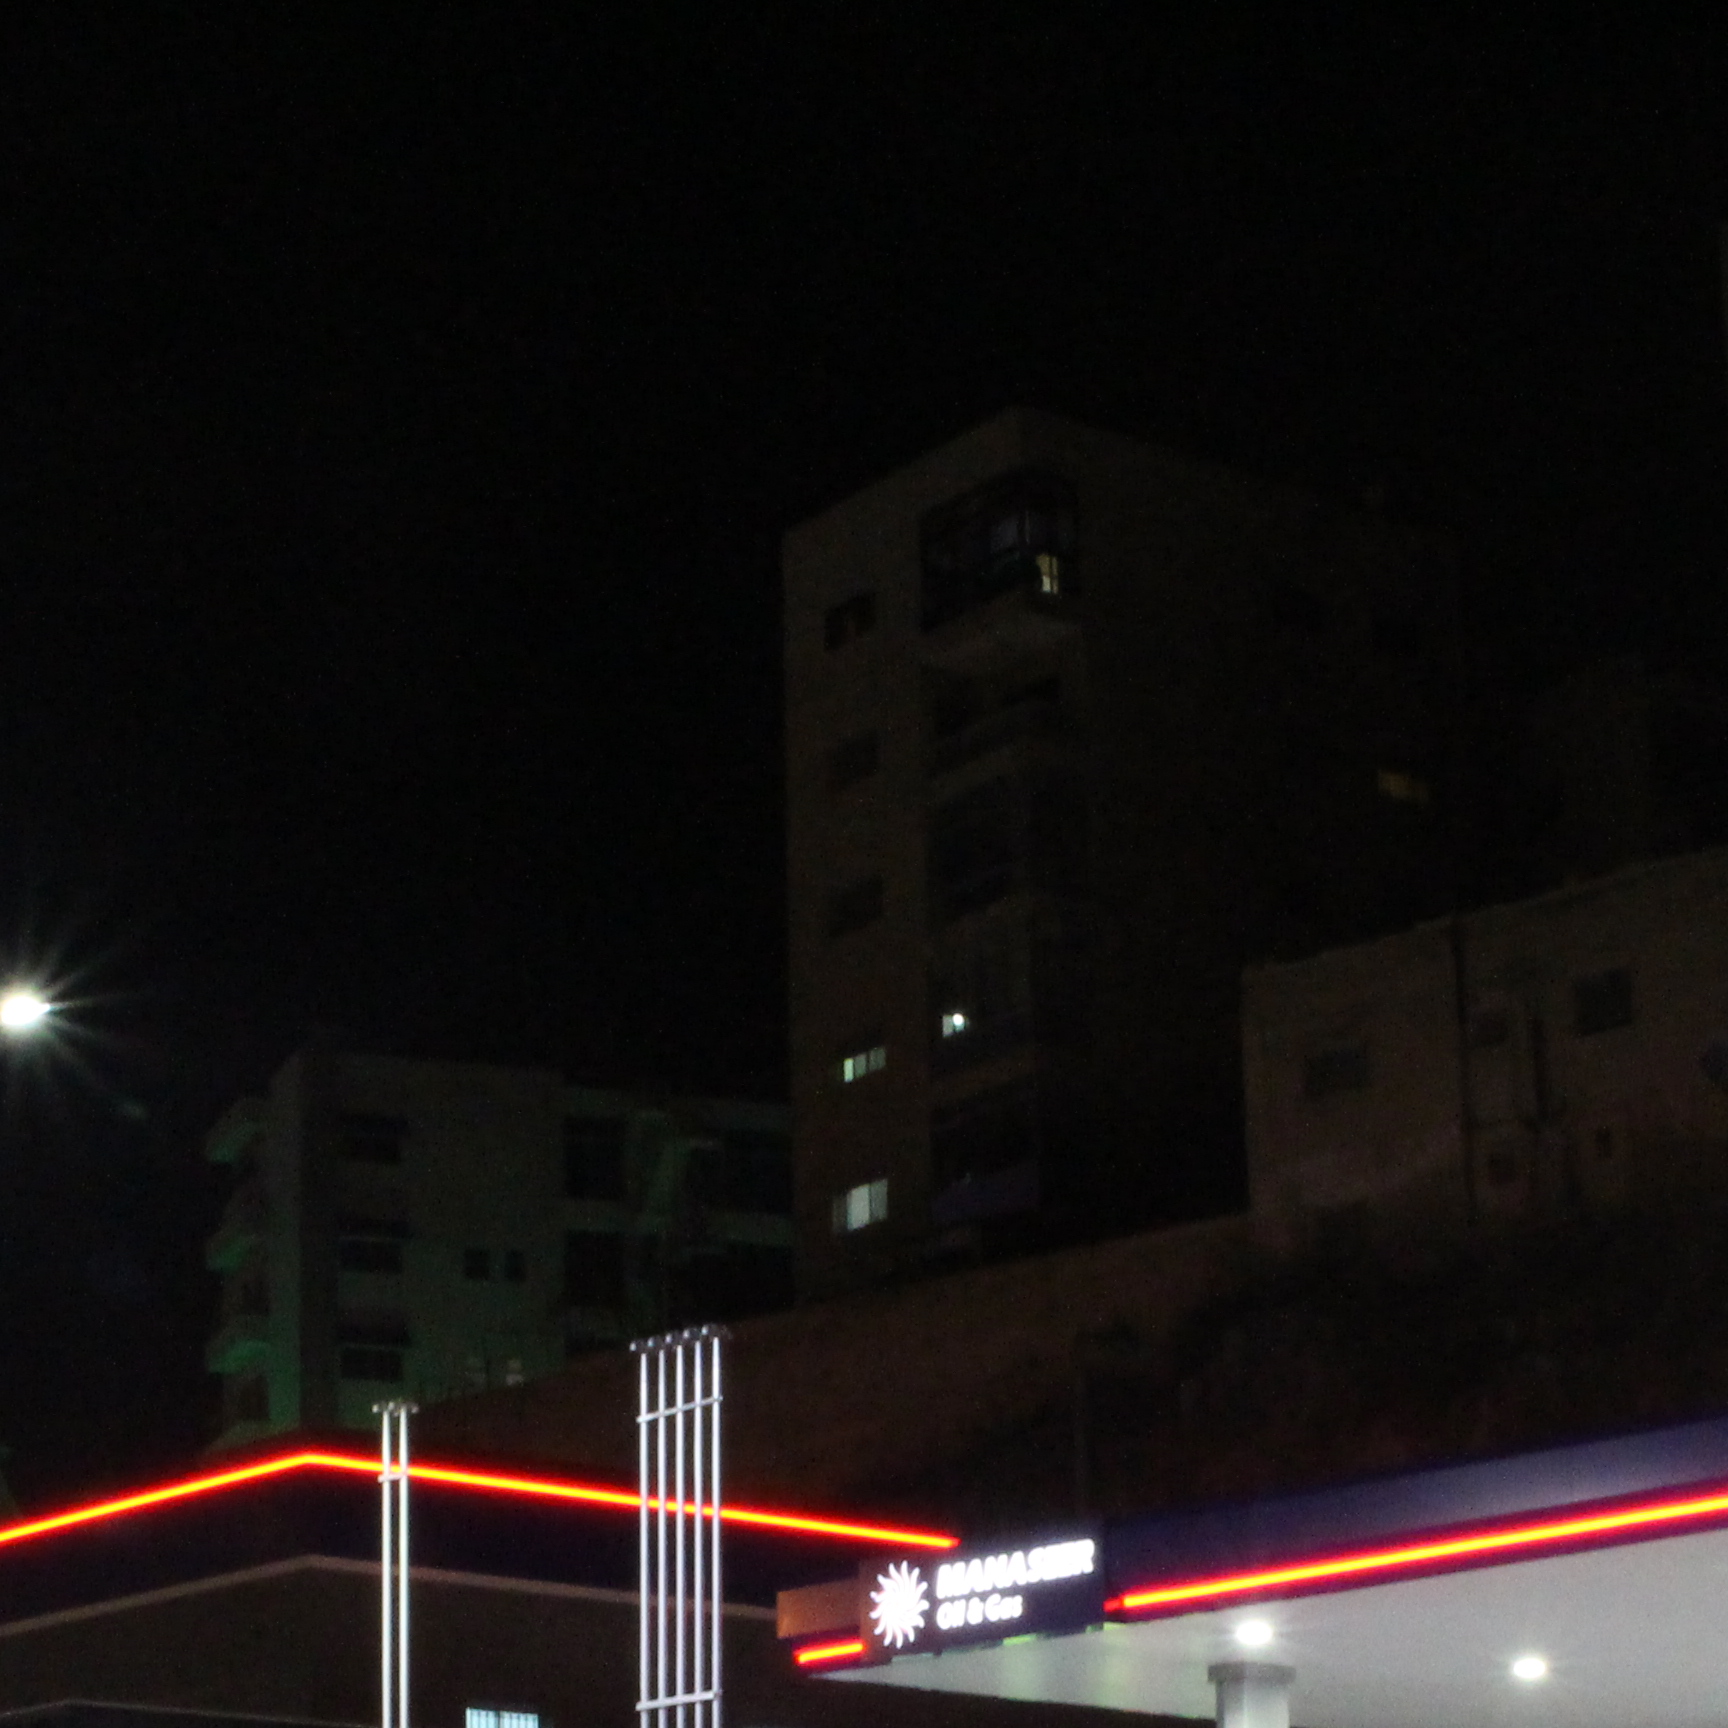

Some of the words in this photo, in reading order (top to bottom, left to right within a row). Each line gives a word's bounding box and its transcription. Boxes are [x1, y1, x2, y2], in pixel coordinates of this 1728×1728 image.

[936, 1539, 1095, 1599] MANASEER
[936, 1599, 967, 1629] Oil
[967, 1597, 984, 1624] &
[985, 1593, 1023, 1622] Gas
